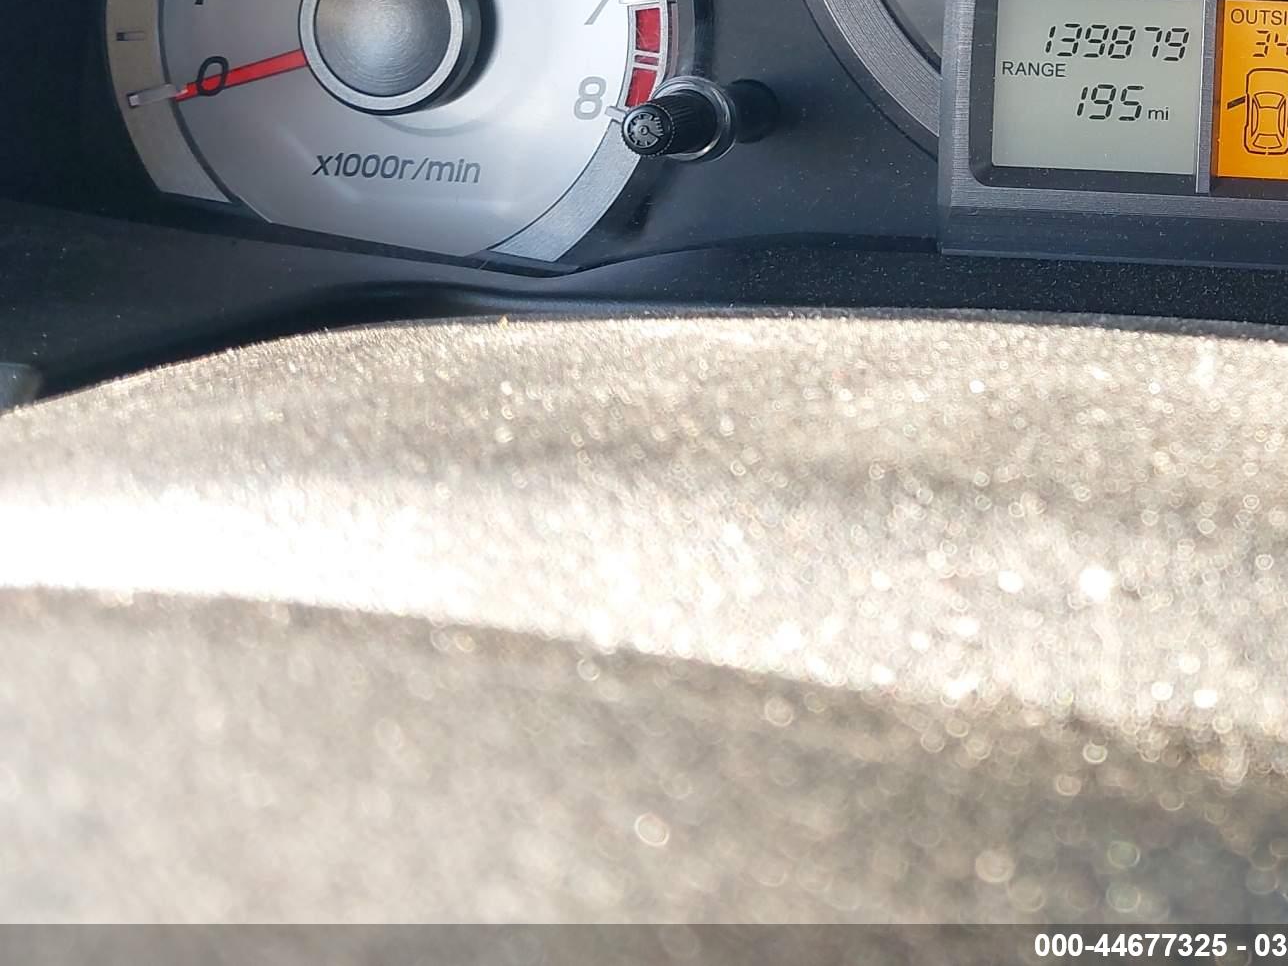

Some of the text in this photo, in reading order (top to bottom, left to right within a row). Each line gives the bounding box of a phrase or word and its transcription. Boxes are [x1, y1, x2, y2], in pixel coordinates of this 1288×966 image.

[1044, 23, 1190, 62] 139879
[196, 55, 229, 96] 0
[1001, 60, 1067, 78] RANGE
[573, 76, 607, 119] 8
[1075, 84, 1170, 122] 195 mi
[311, 152, 481, 183] x1000r/min
